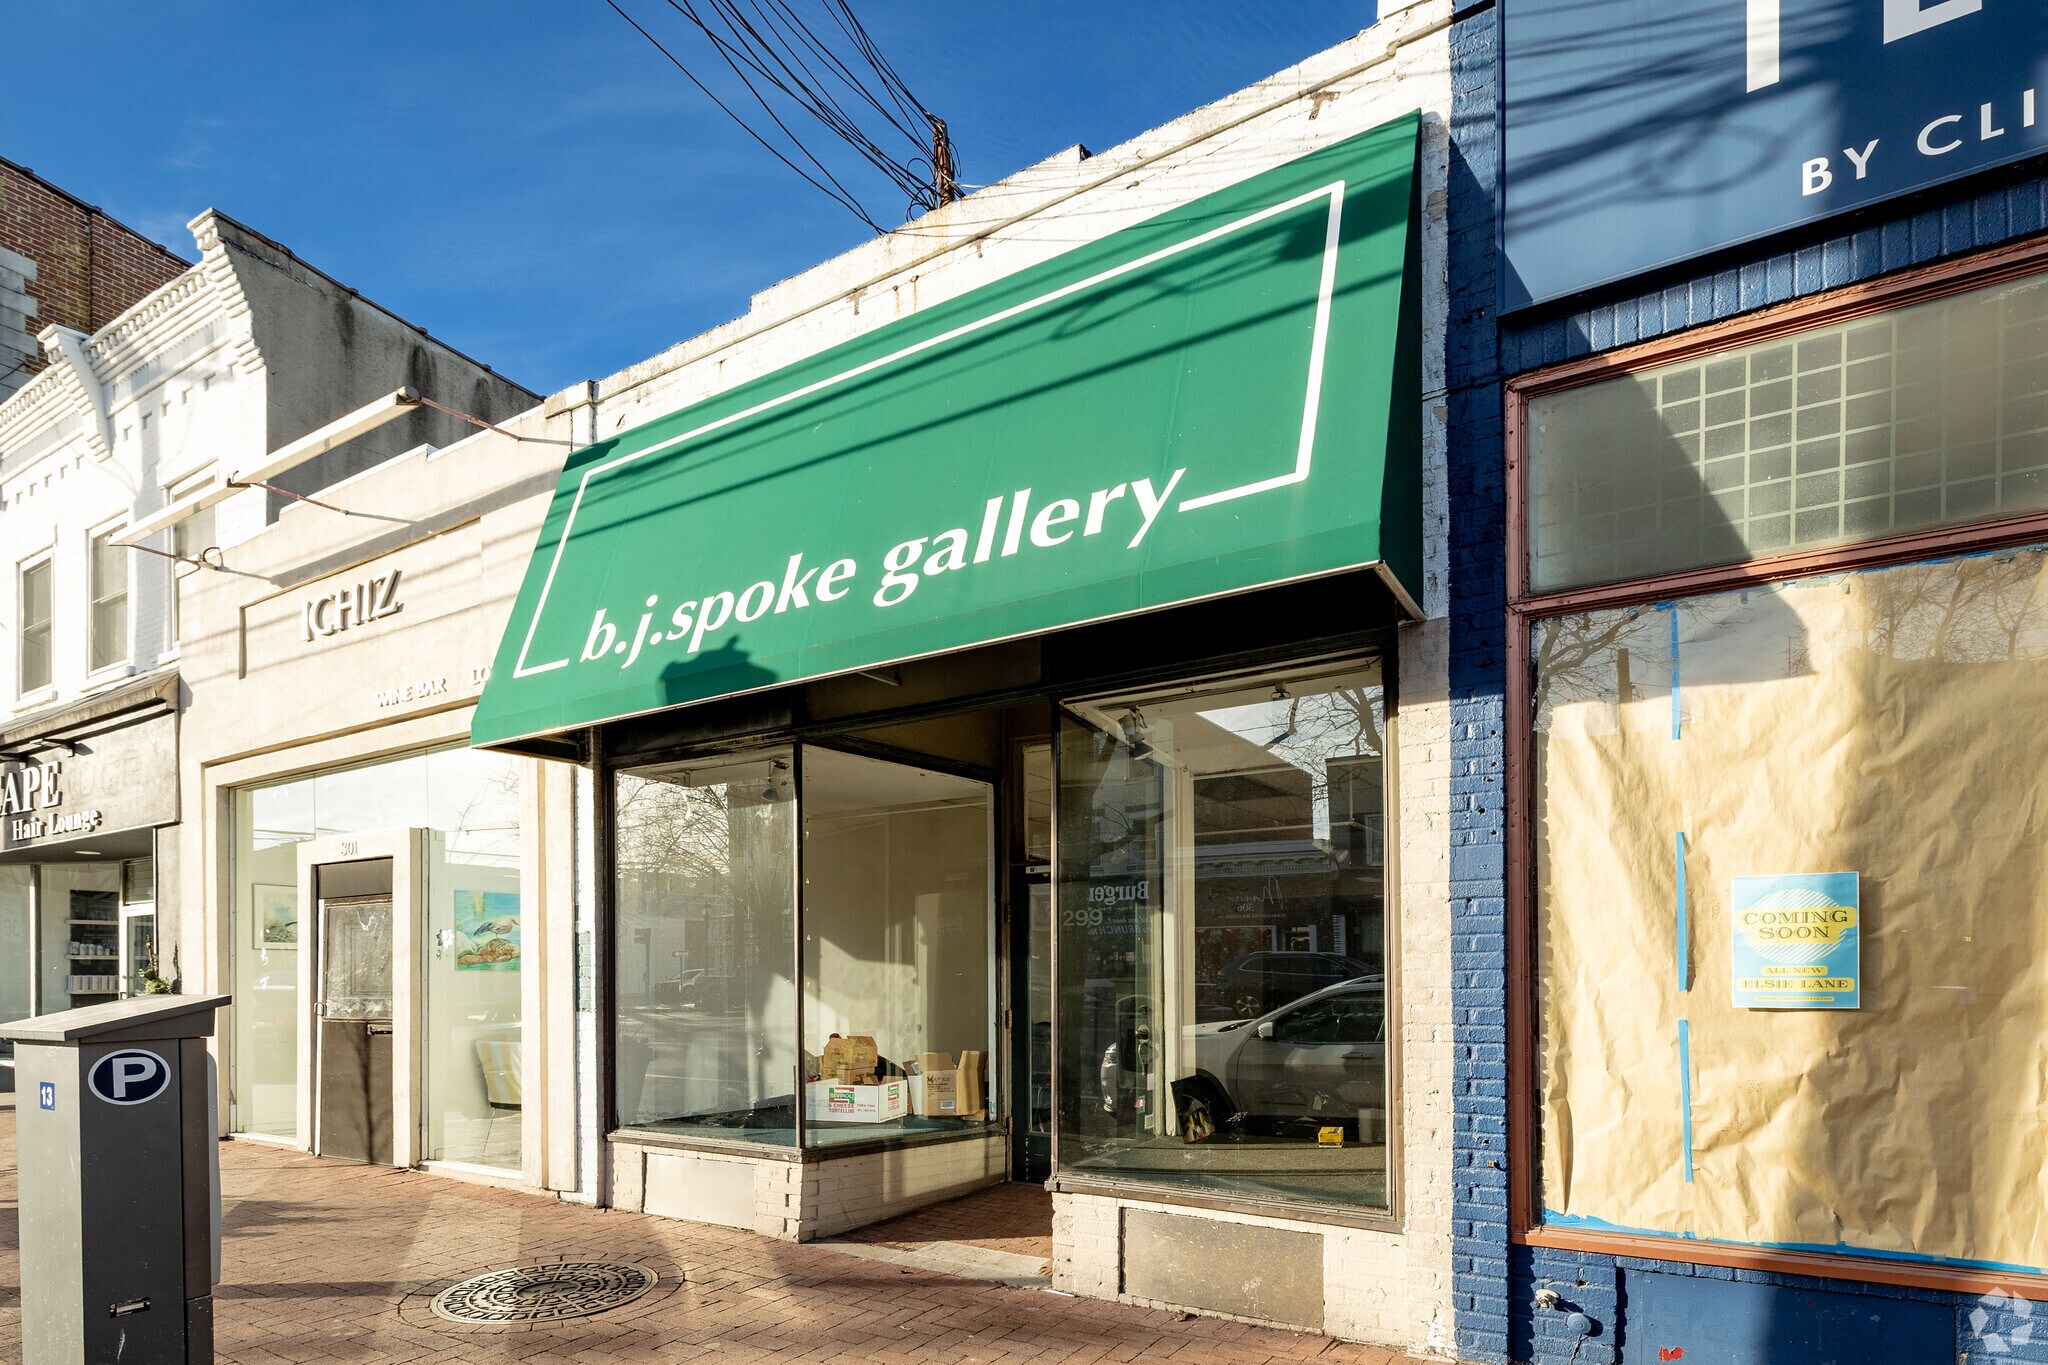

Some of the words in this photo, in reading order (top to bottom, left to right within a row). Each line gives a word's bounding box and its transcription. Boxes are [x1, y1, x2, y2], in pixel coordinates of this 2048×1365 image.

[1801, 138, 1880, 197] BY
[578, 552, 857, 668] b.j.spoke
[873, 467, 1187, 608] gallery
[301, 568, 404, 642] ICHIZ
[417, 677, 448, 699] BAR
[0, 761, 62, 817] APE
[12, 816, 47, 841] Hair
[47, 809, 103, 835] Lounge
[341, 841, 359, 857] 301
[1062, 910, 1103, 927] 299
[1743, 910, 1848, 925] COMING
[1759, 926, 1830, 939] SOON
[1744, 980, 1793, 989] ELSIE
[1802, 980, 1849, 989] LANE
[112, 1056, 157, 1098] P
[41, 1086, 53, 1106] 13
